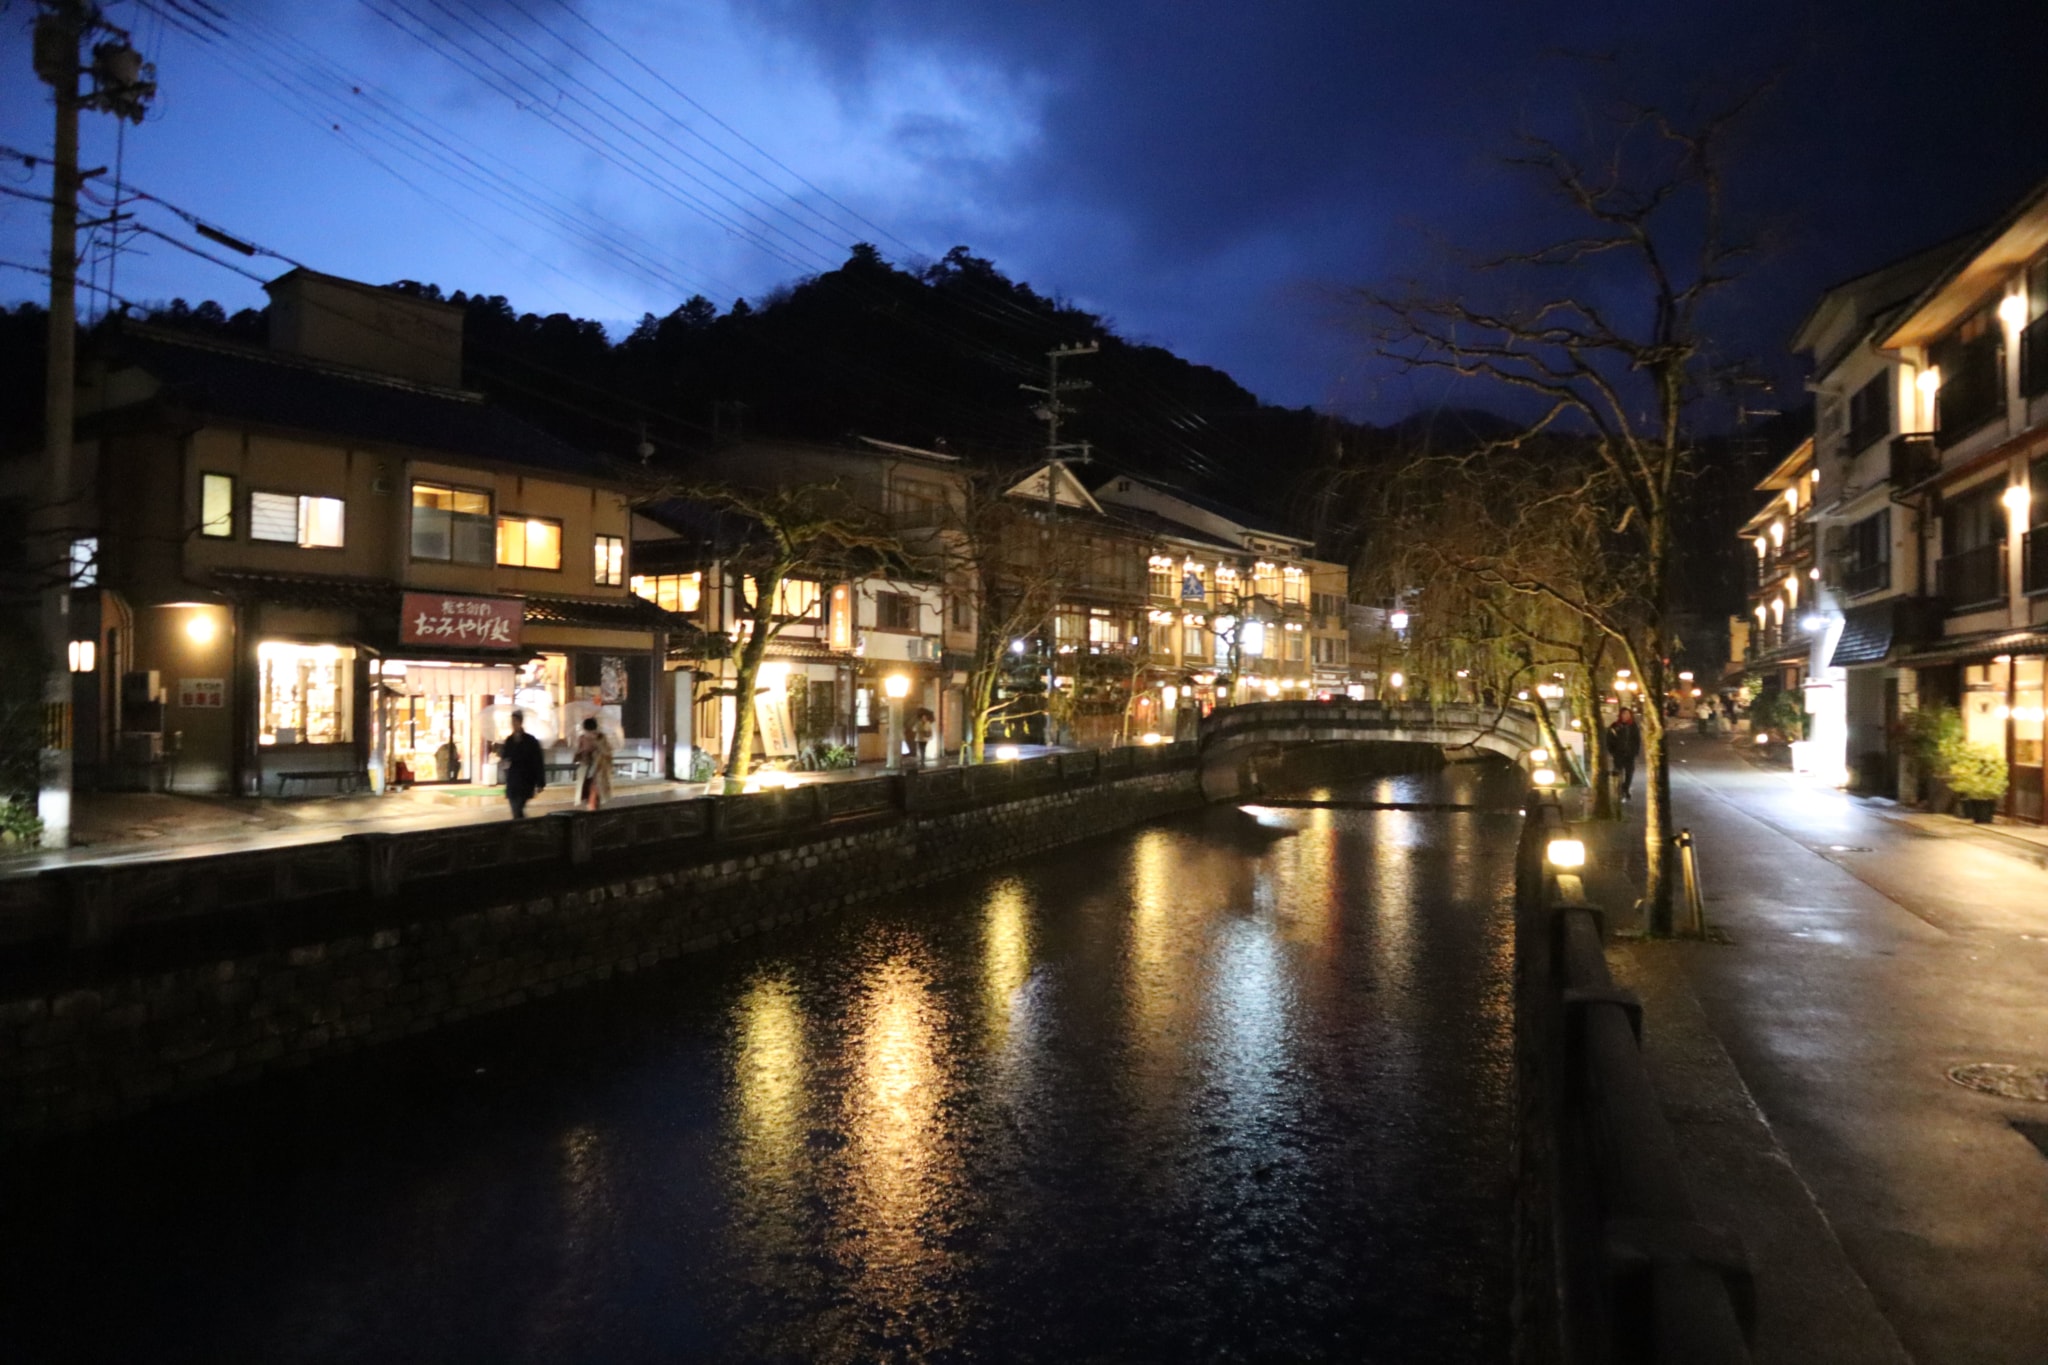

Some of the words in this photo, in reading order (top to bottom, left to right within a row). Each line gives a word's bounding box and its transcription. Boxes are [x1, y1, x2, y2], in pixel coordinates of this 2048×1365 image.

[414, 612, 511, 643] おみやげ処
